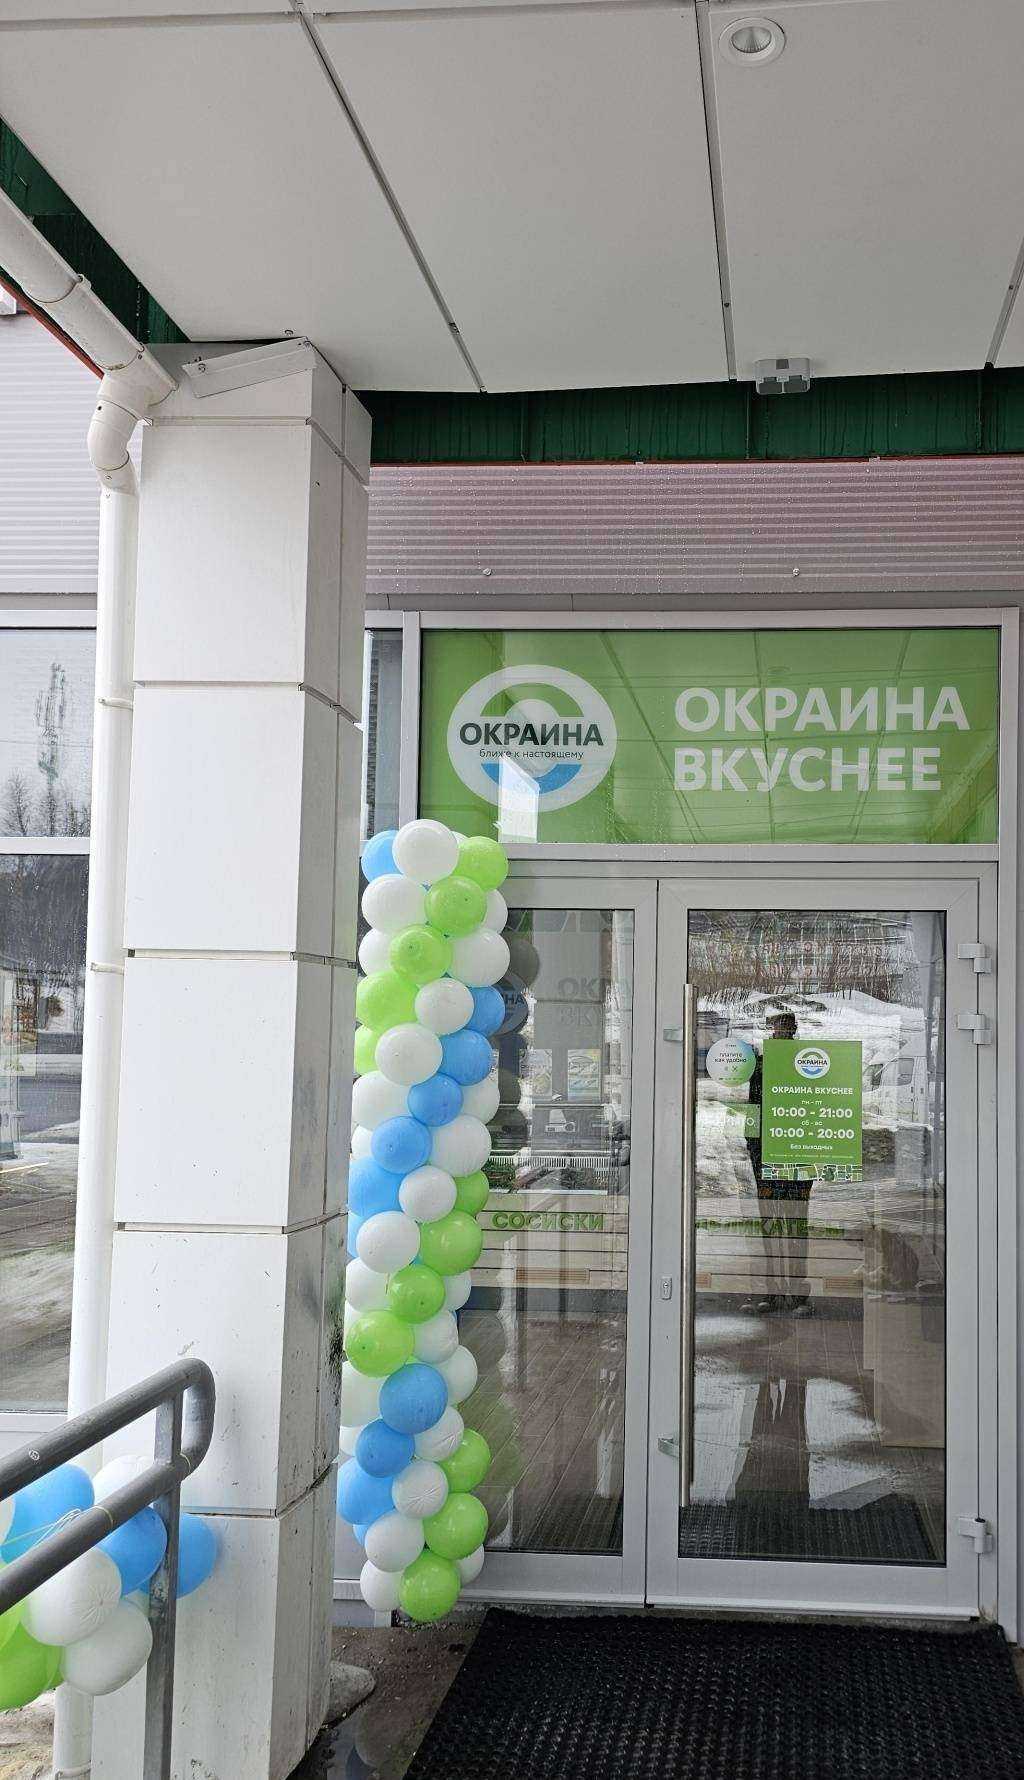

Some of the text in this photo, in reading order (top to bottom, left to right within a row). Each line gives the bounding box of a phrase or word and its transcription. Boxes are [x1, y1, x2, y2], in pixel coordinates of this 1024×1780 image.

[674, 686, 971, 732] ОКРАИНА
[459, 722, 604, 746] ОКРАИНА
[479, 749, 511, 758] ближе
[522, 751, 584, 760] настоящему
[674, 747, 941, 792] ВКУСНЕЕ
[771, 1086, 854, 1095] ОКРАИНА ВКУСНЕЕ
[771, 1106, 807, 1118] 10:00
[818, 1107, 853, 1119] 21:00
[769, 1127, 805, 1138] 10:00
[817, 1128, 855, 1140] 20:00
[492, 1212, 604, 1231] СОСИСКИ
